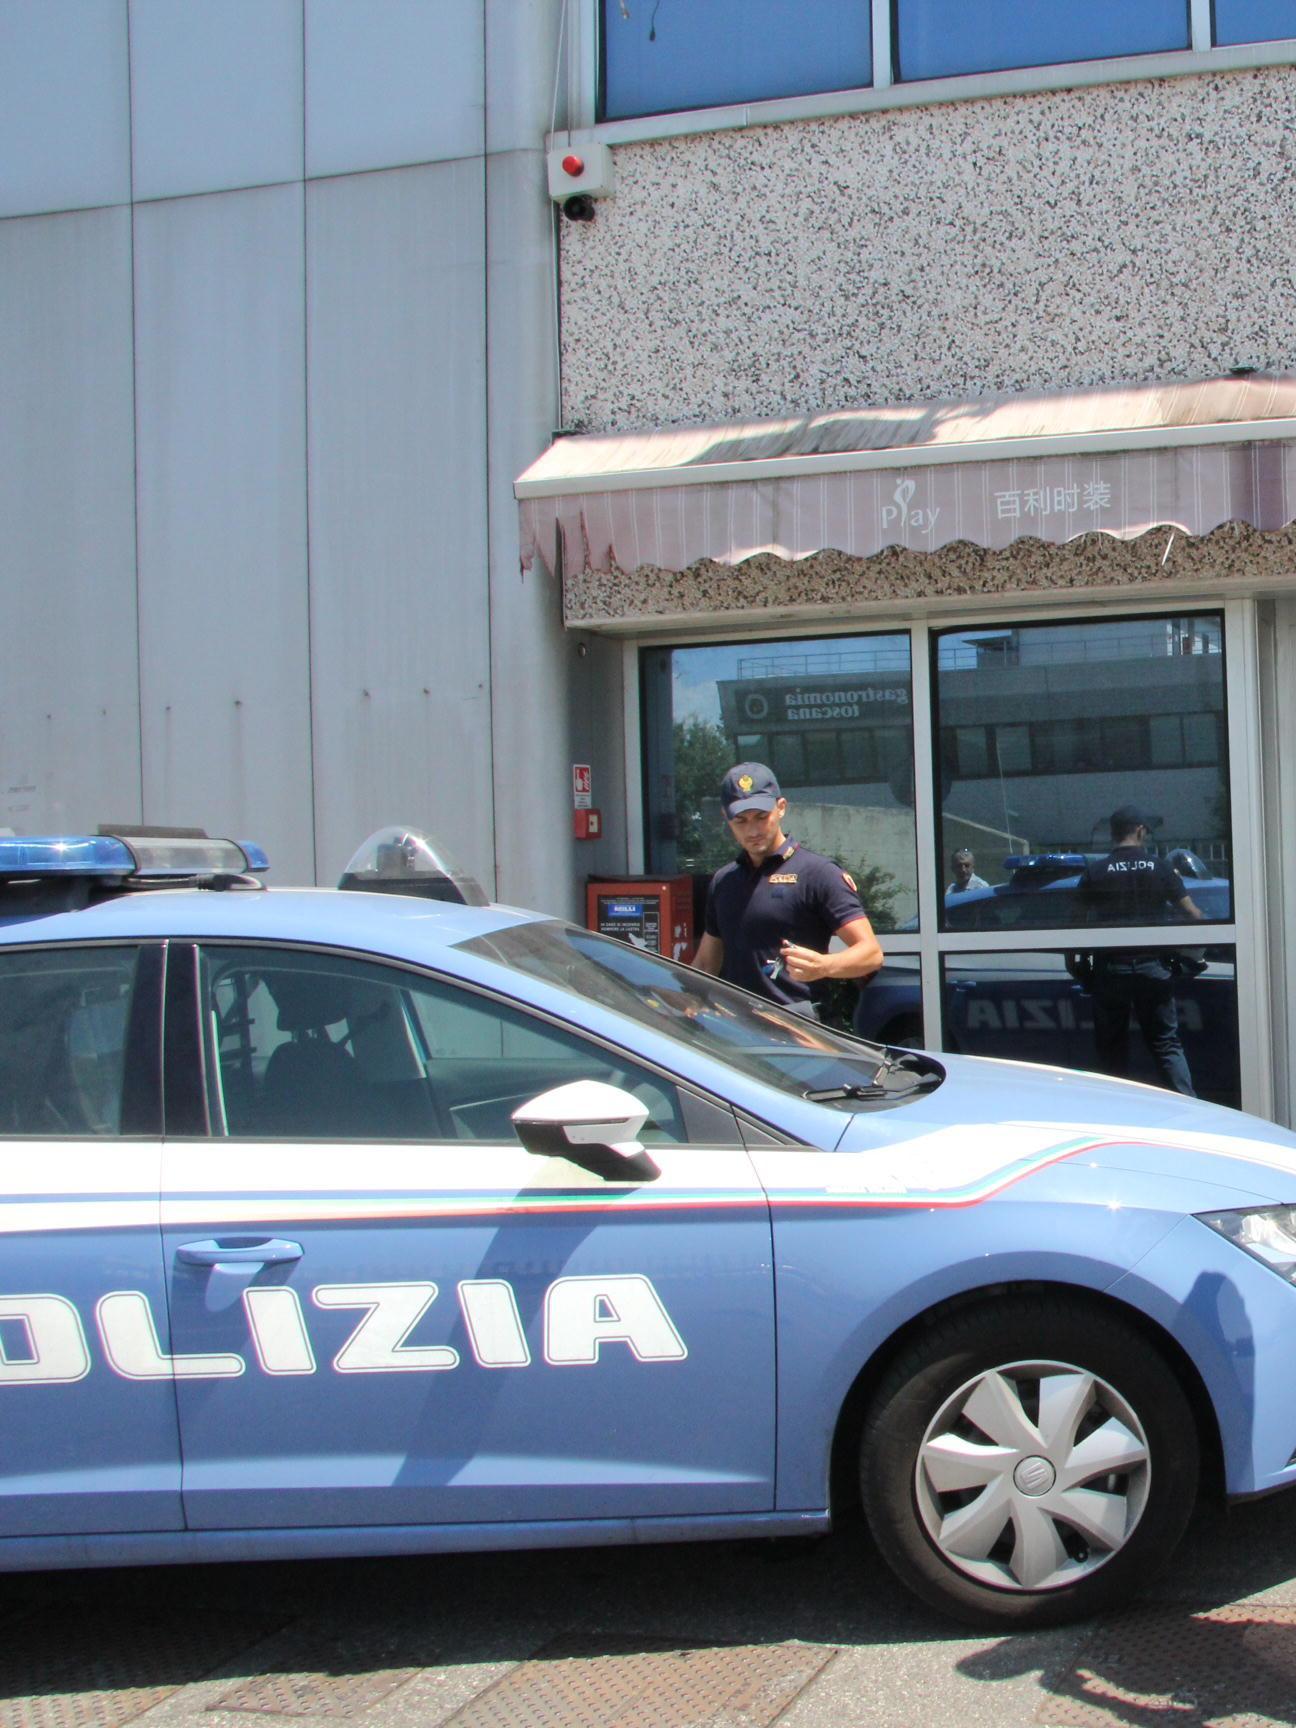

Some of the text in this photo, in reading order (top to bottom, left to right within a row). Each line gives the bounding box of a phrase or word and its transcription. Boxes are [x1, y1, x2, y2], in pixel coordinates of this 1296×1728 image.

[881, 478, 940, 534] Play
[993, 480, 1111, 519] 百利时装
[0, 1274, 688, 1385] OLIZIA
